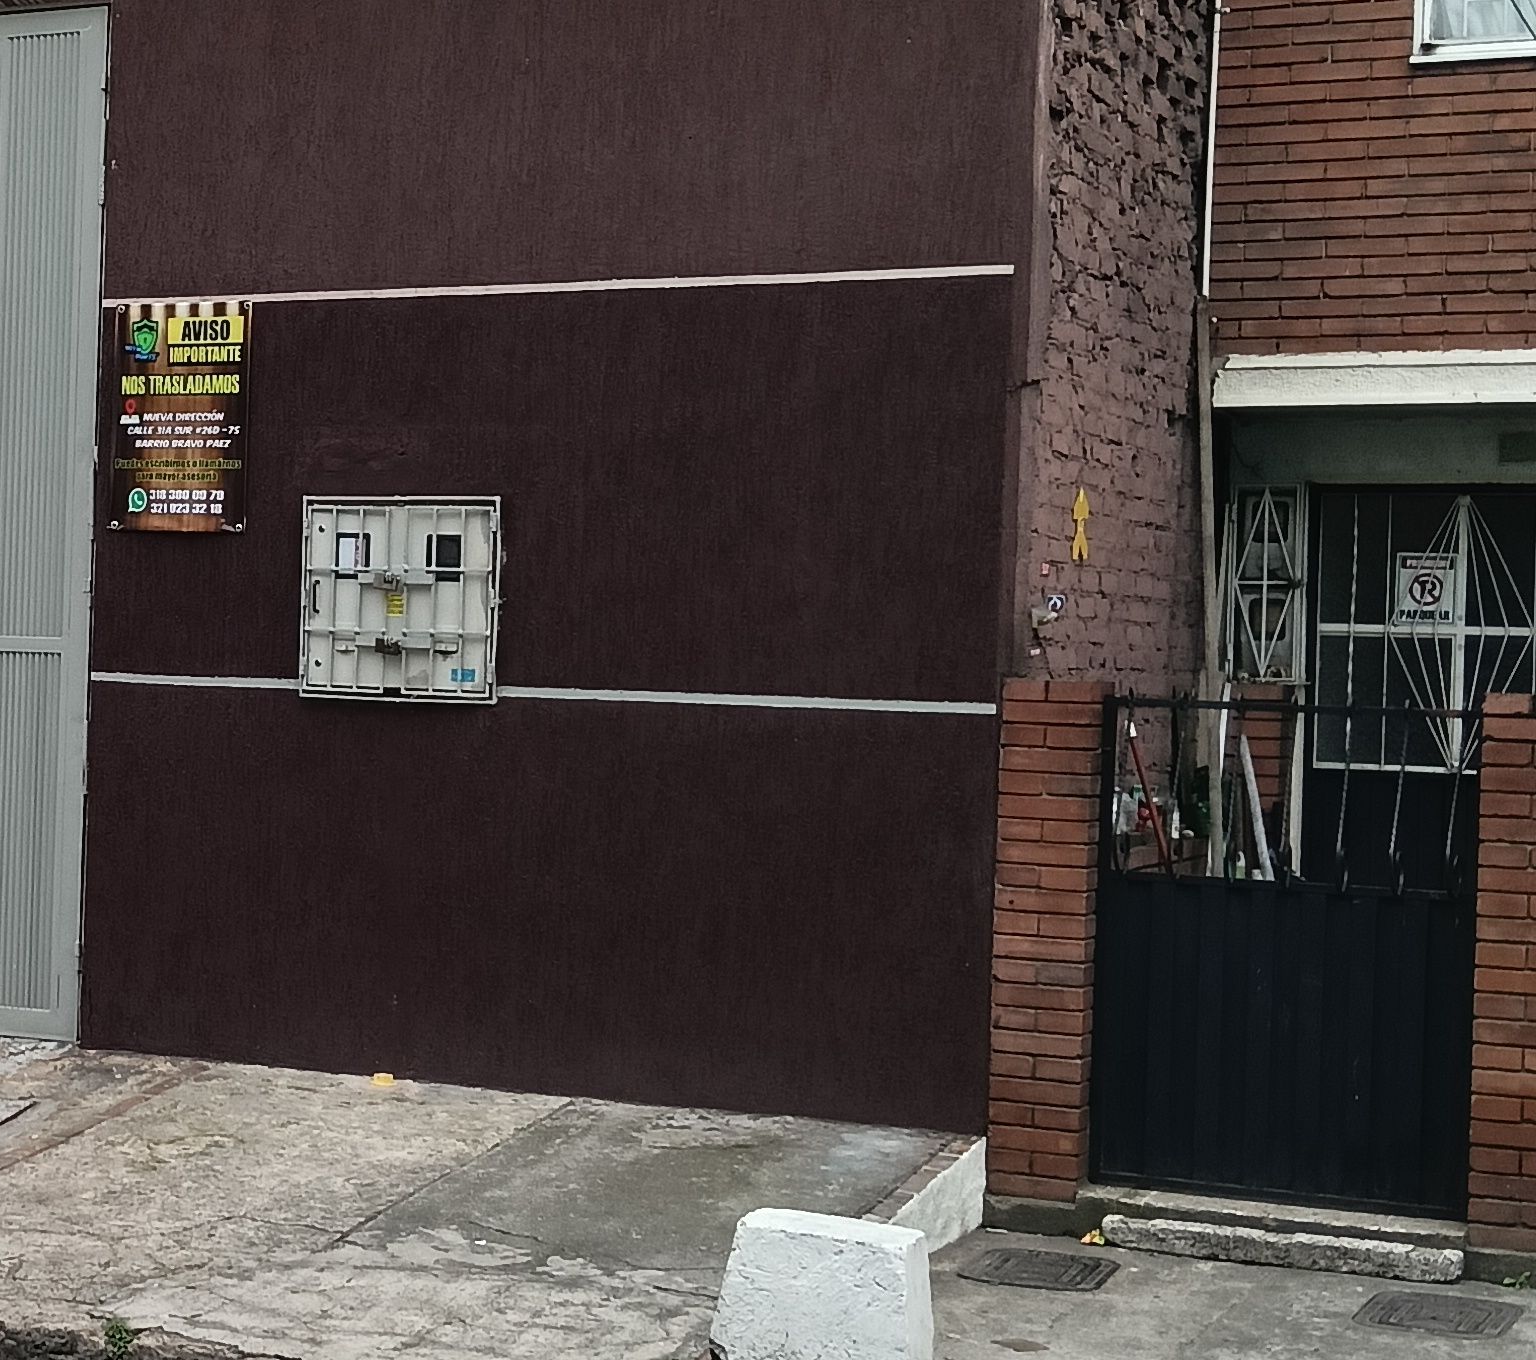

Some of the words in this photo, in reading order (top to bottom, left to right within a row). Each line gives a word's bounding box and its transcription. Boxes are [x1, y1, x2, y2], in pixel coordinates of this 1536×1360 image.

[181, 320, 231, 341] AVISO
[169, 346, 242, 363] IMPORTANTE
[121, 375, 146, 395] NOS
[148, 374, 240, 395] TRASLADAMOS
[142, 412, 173, 422] NUEVA
[175, 409, 225, 422] DIRECCIÓN
[127, 426, 153, 435] CALLE
[173, 426, 193, 435] SUR
[135, 439, 170, 448] BARRIO
[171, 439, 204, 448] BRAVO
[205, 439, 232, 448] PAEZ
